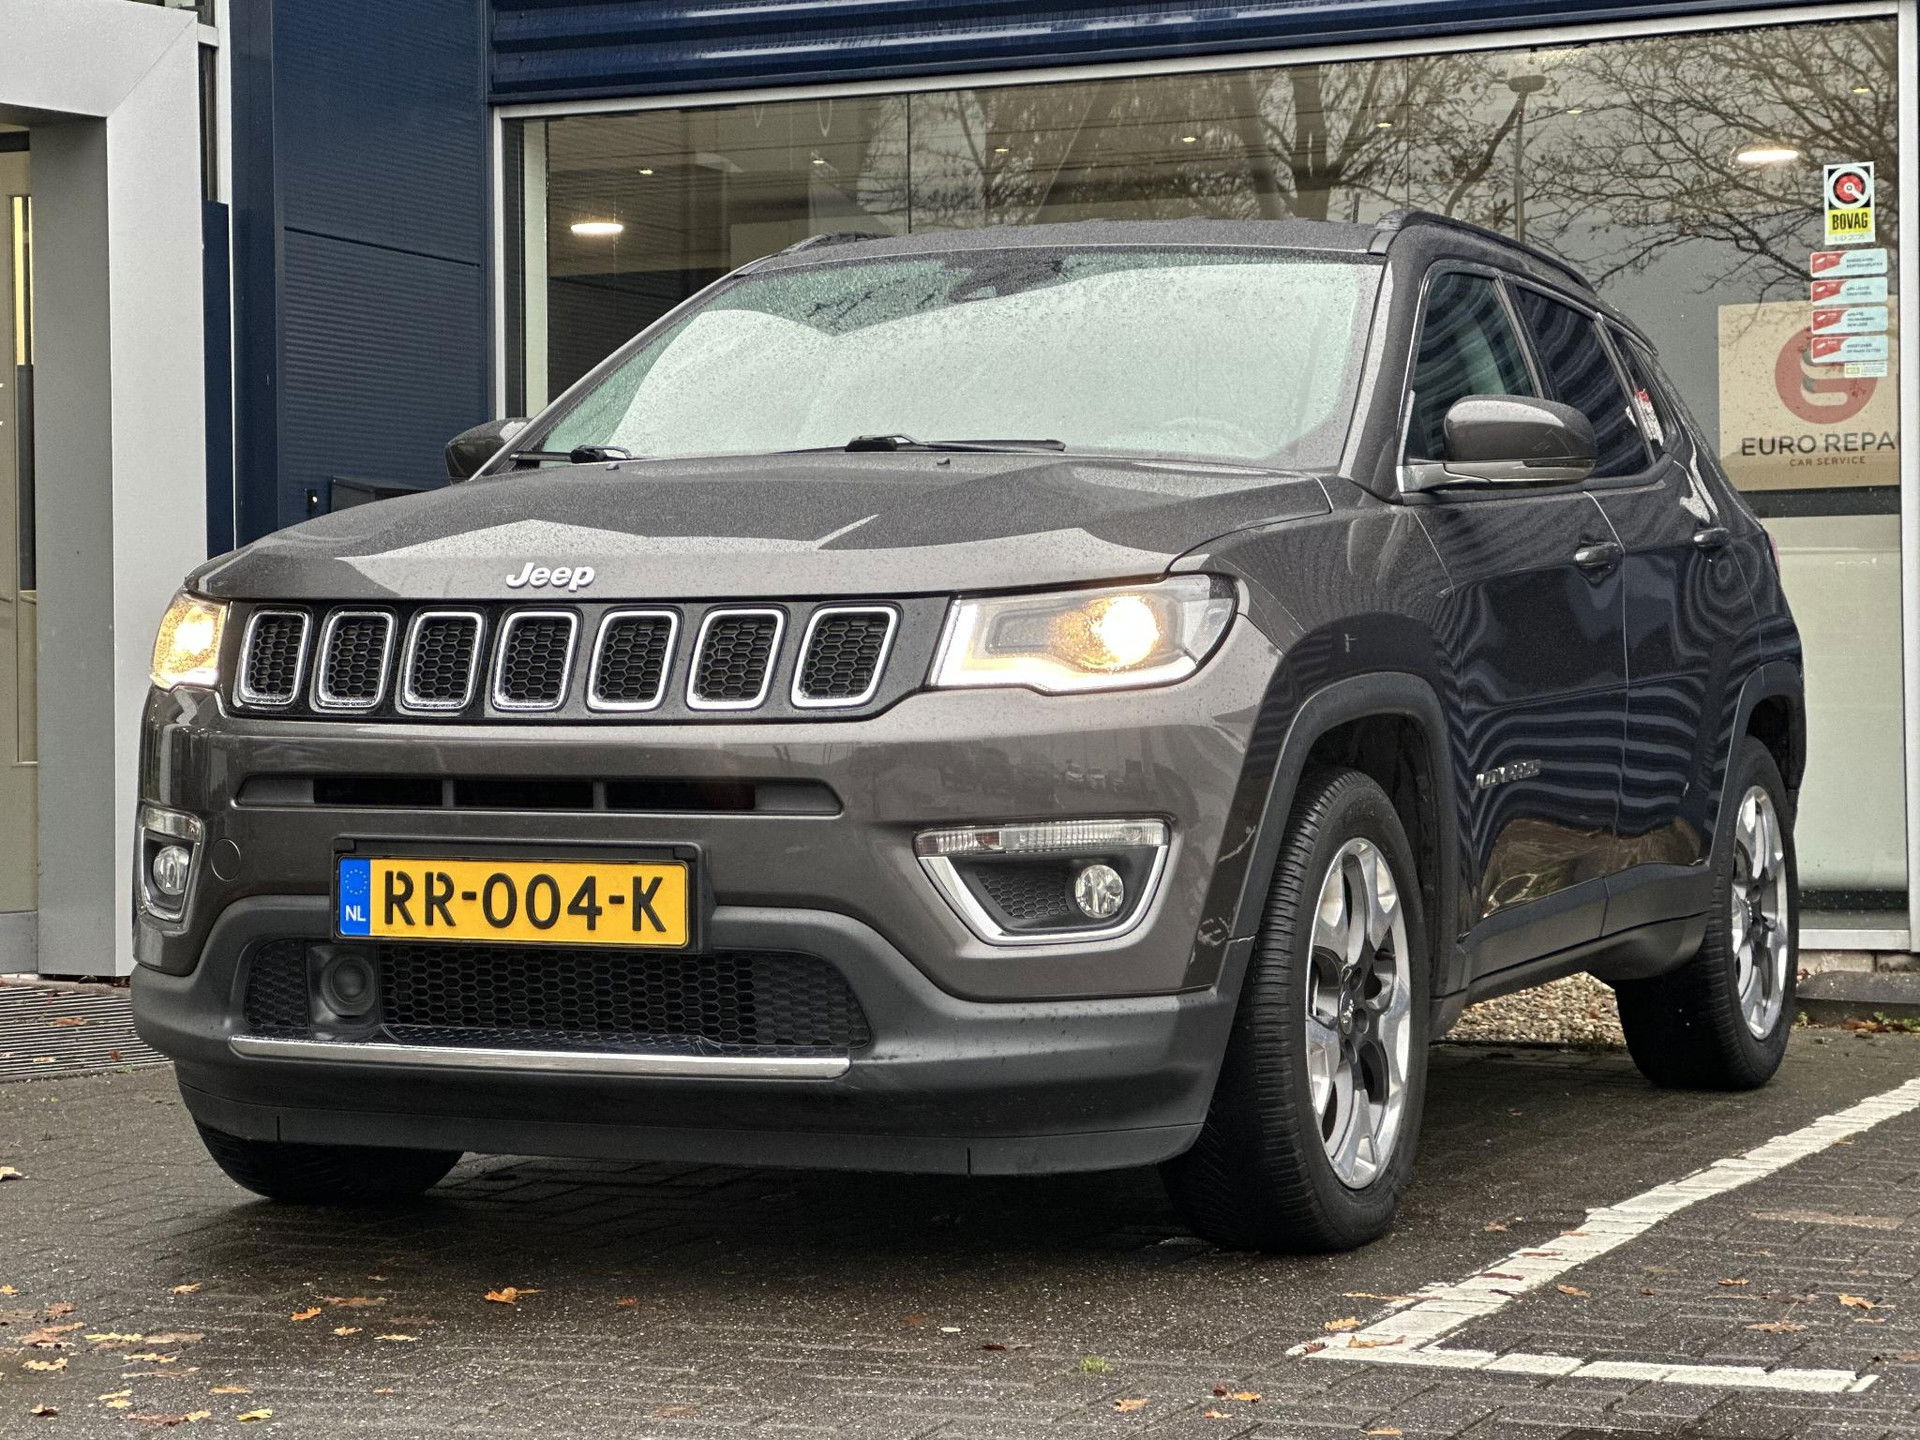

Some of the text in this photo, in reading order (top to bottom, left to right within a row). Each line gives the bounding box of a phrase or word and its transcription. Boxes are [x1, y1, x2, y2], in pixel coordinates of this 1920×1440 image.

[1832, 212, 1868, 230] BOVAG
[1741, 435, 1816, 456] EURO
[1789, 456, 1866, 467] CAR SERVICE
[505, 562, 595, 593] Jeep
[345, 870, 667, 933] NL RR-004-K
